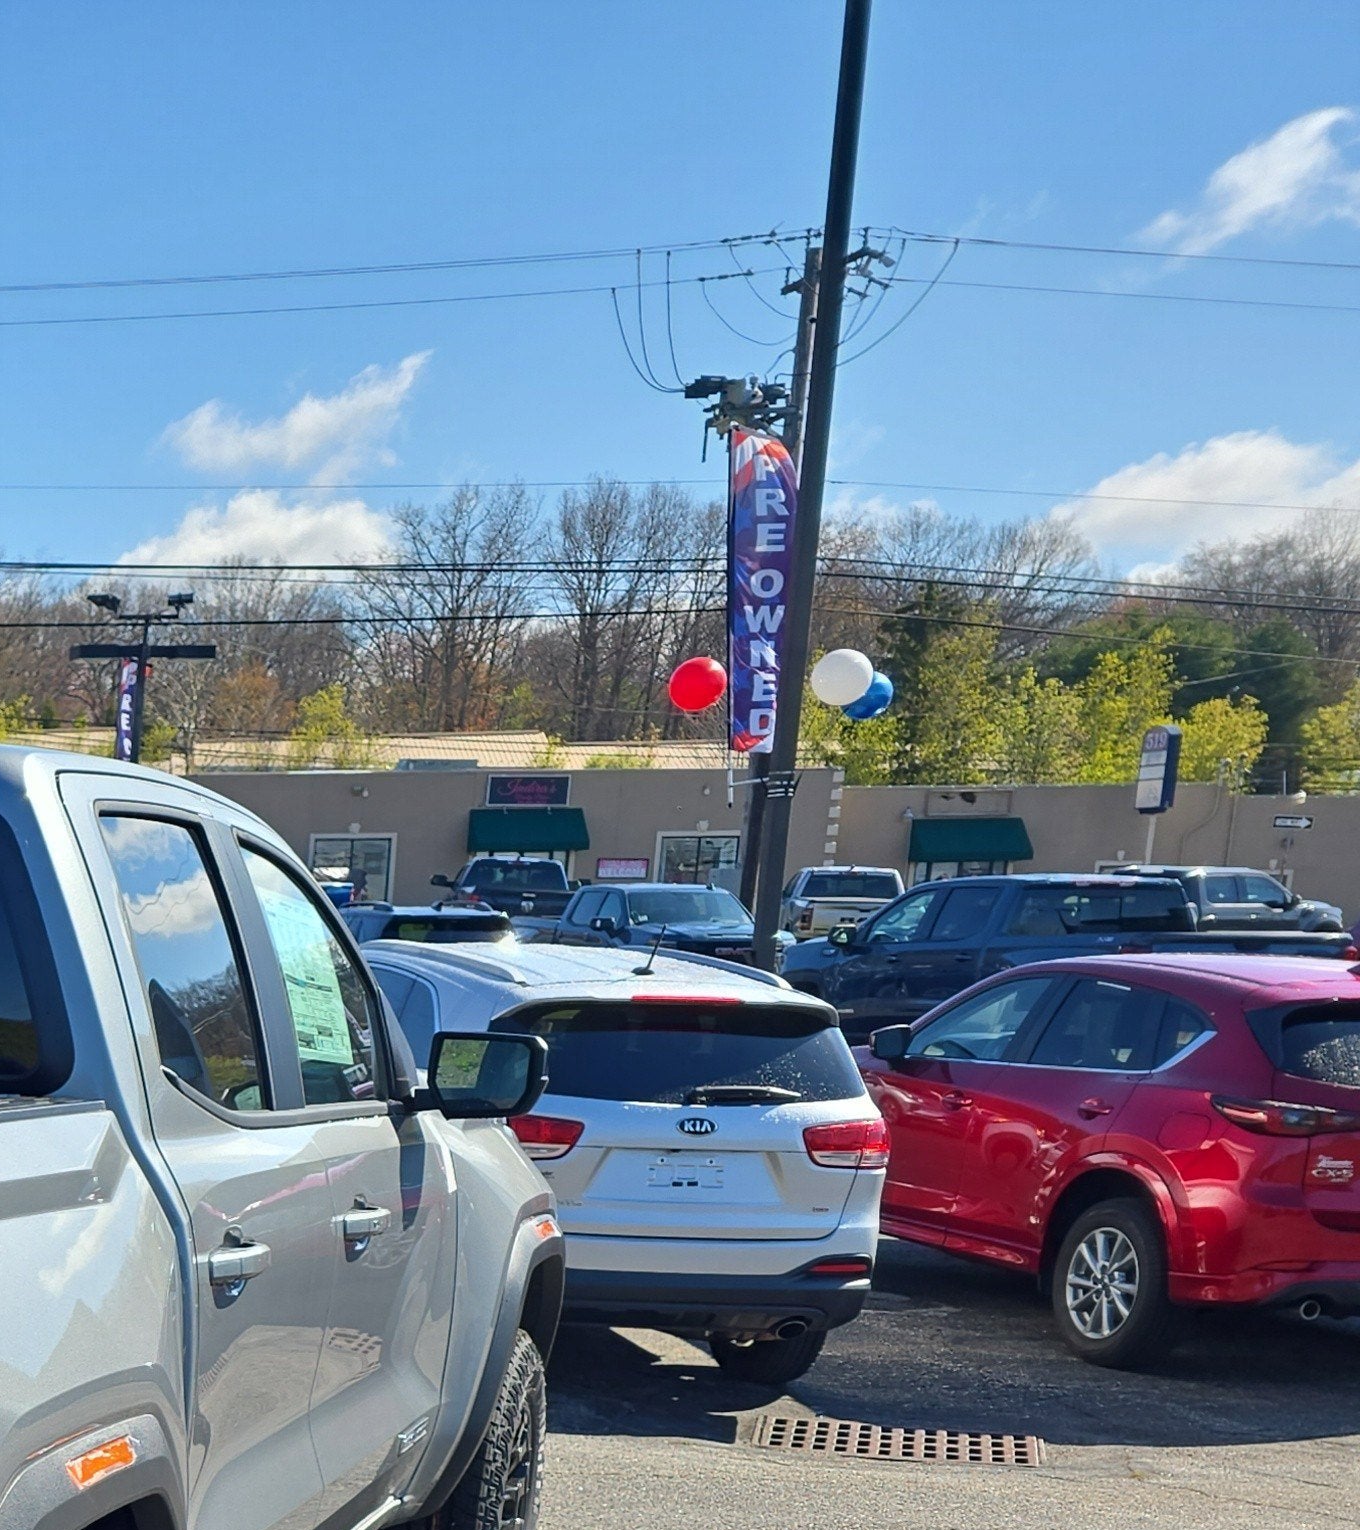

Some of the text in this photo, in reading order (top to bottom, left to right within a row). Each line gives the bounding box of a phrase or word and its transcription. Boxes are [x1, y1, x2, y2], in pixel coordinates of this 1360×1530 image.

[743, 454, 790, 738] PRE OWNED
[683, 1119, 712, 1133] KIA
[1311, 1168, 1354, 1179] CX-5
